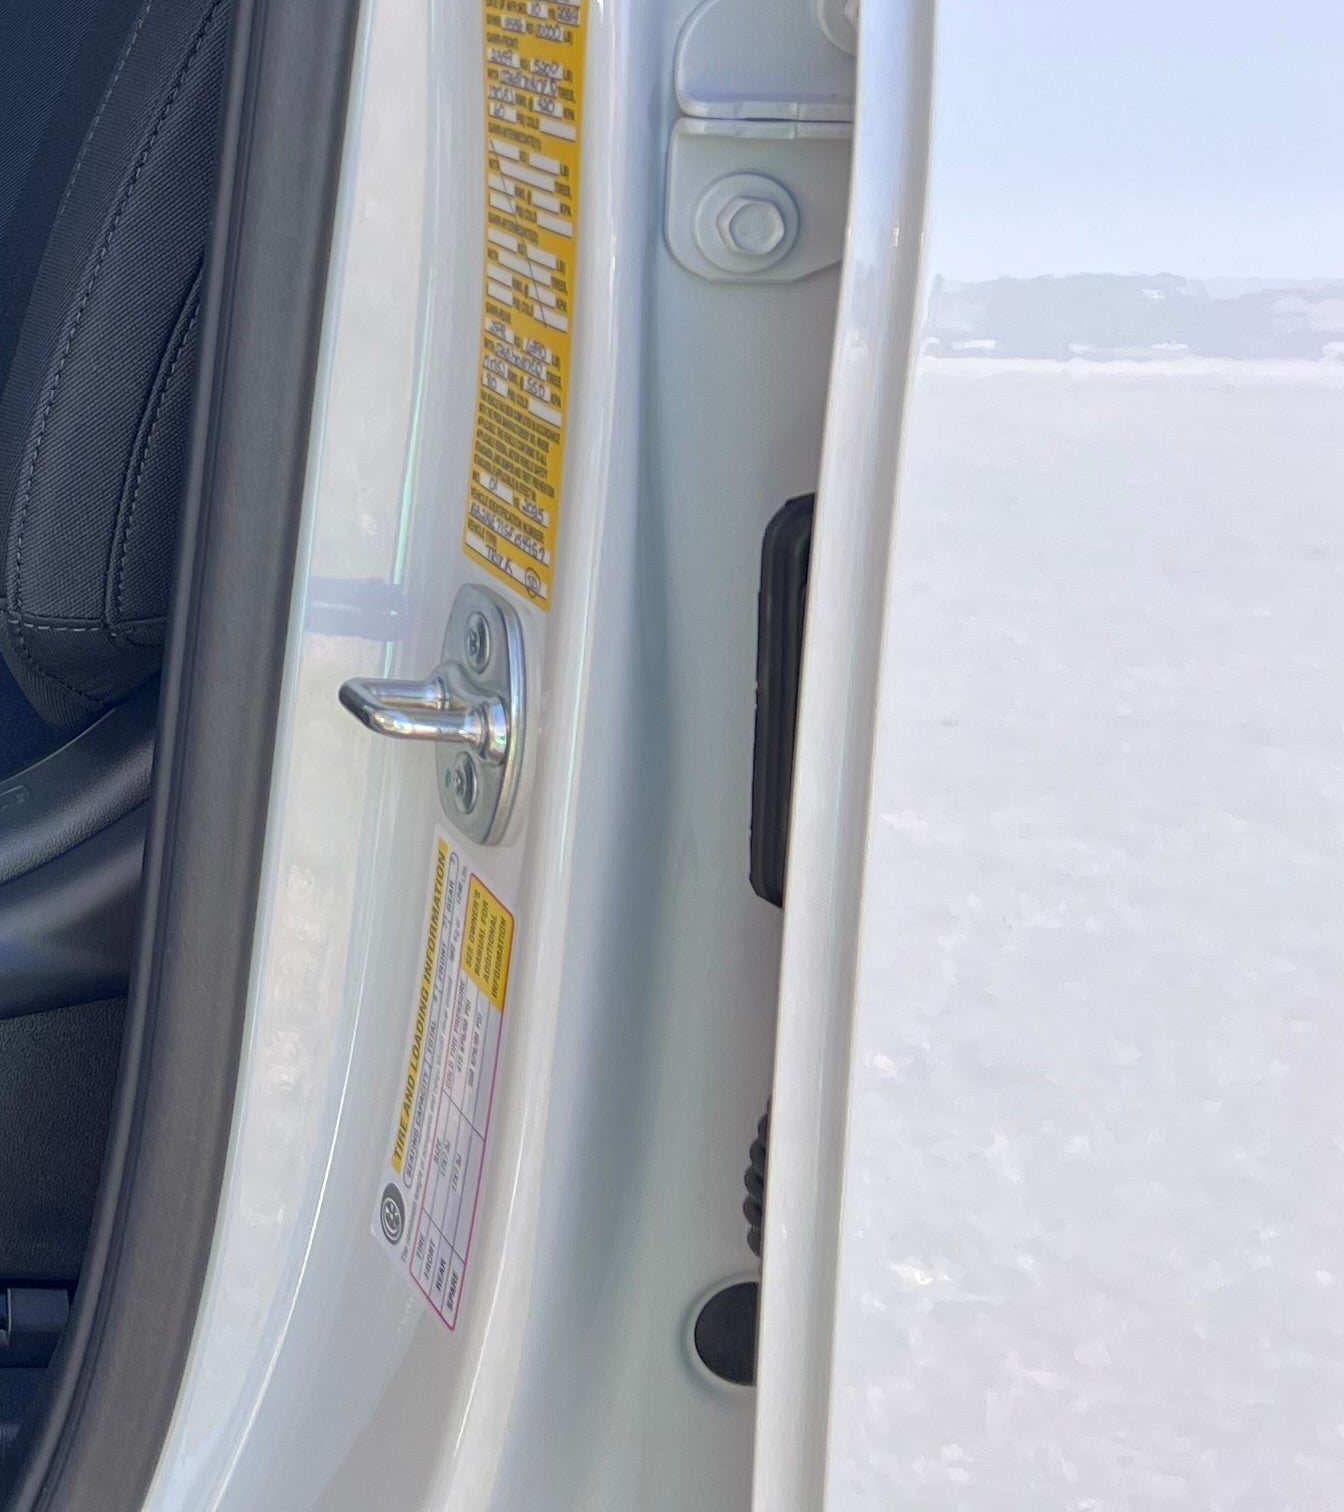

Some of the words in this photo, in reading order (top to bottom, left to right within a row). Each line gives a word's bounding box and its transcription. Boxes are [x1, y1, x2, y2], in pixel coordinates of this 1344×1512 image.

[465, 944, 473, 968] SEE
[469, 888, 480, 944] OWNER'S
[474, 926, 486, 977] MANUAL
[481, 899, 489, 925] FOR
[483, 914, 497, 984] ADDITIONAL
[491, 916, 506, 999] INFORMATION
[393, 1120, 408, 1161] TIRE
[403, 1074, 416, 1116] AND
[410, 987, 429, 1072] LOADING
[424, 850, 446, 986] INFORMATION
[407, 1127, 419, 1178] SEATING
[416, 1071, 429, 1126] CAPACITY
[428, 1020, 438, 1054] TOTAL
[438, 942, 447, 982] FRONT
[446, 880, 454, 912] REAR
[424, 1237, 436, 1280] FRONT
[435, 1257, 447, 1293] REAR
[446, 1269, 459, 1312] SPARE
